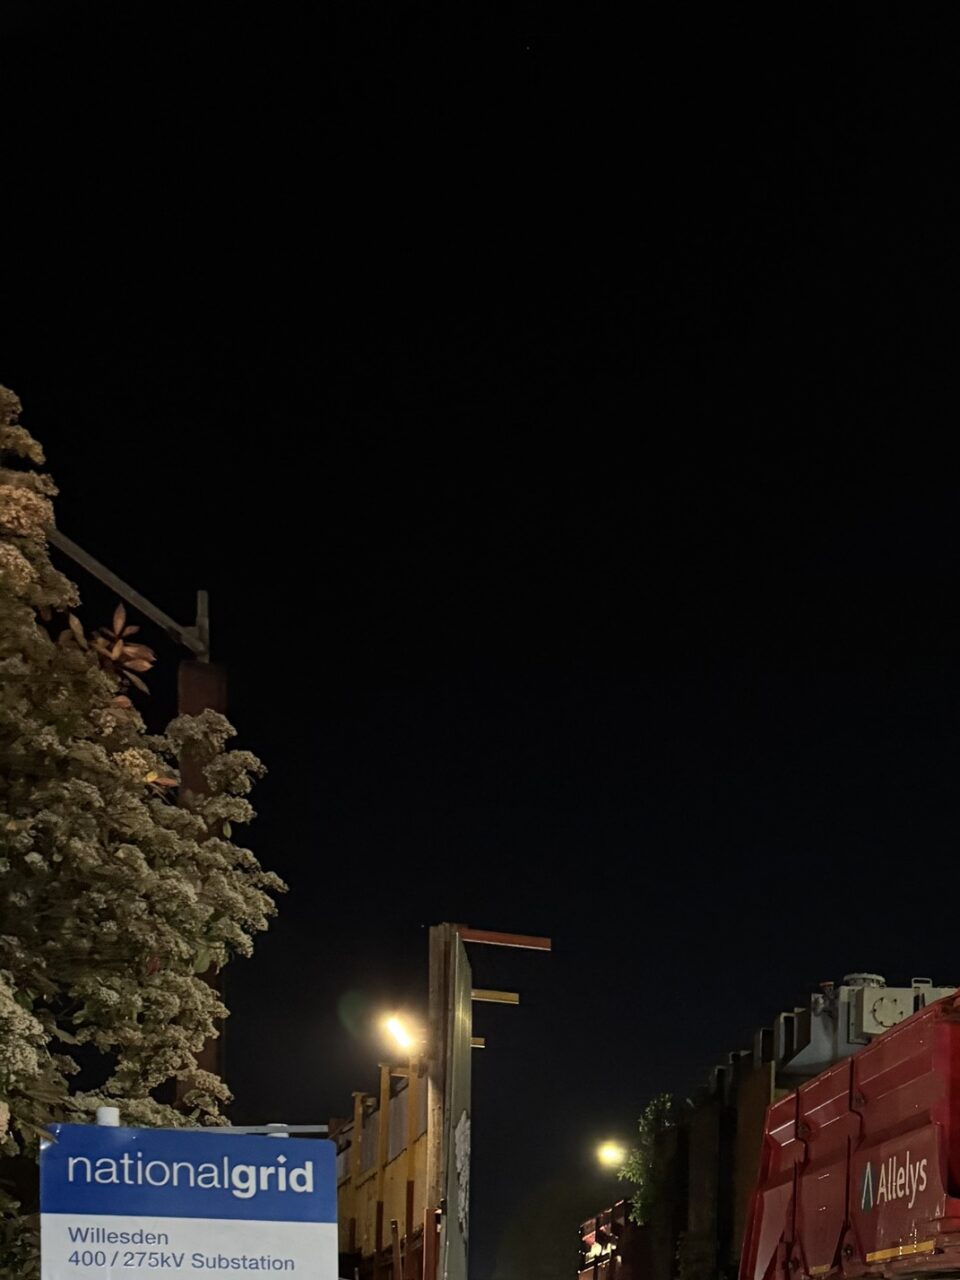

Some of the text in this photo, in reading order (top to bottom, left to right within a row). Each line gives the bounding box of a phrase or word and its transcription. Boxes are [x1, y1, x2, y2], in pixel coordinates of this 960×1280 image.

[67, 1151, 314, 1199] nationalgrid
[876, 1150, 928, 1209] Allelys
[68, 1226, 169, 1246] Willesden
[68, 1250, 106, 1267] 400
[123, 1251, 185, 1268] 275kV
[191, 1252, 295, 1271] Substation
